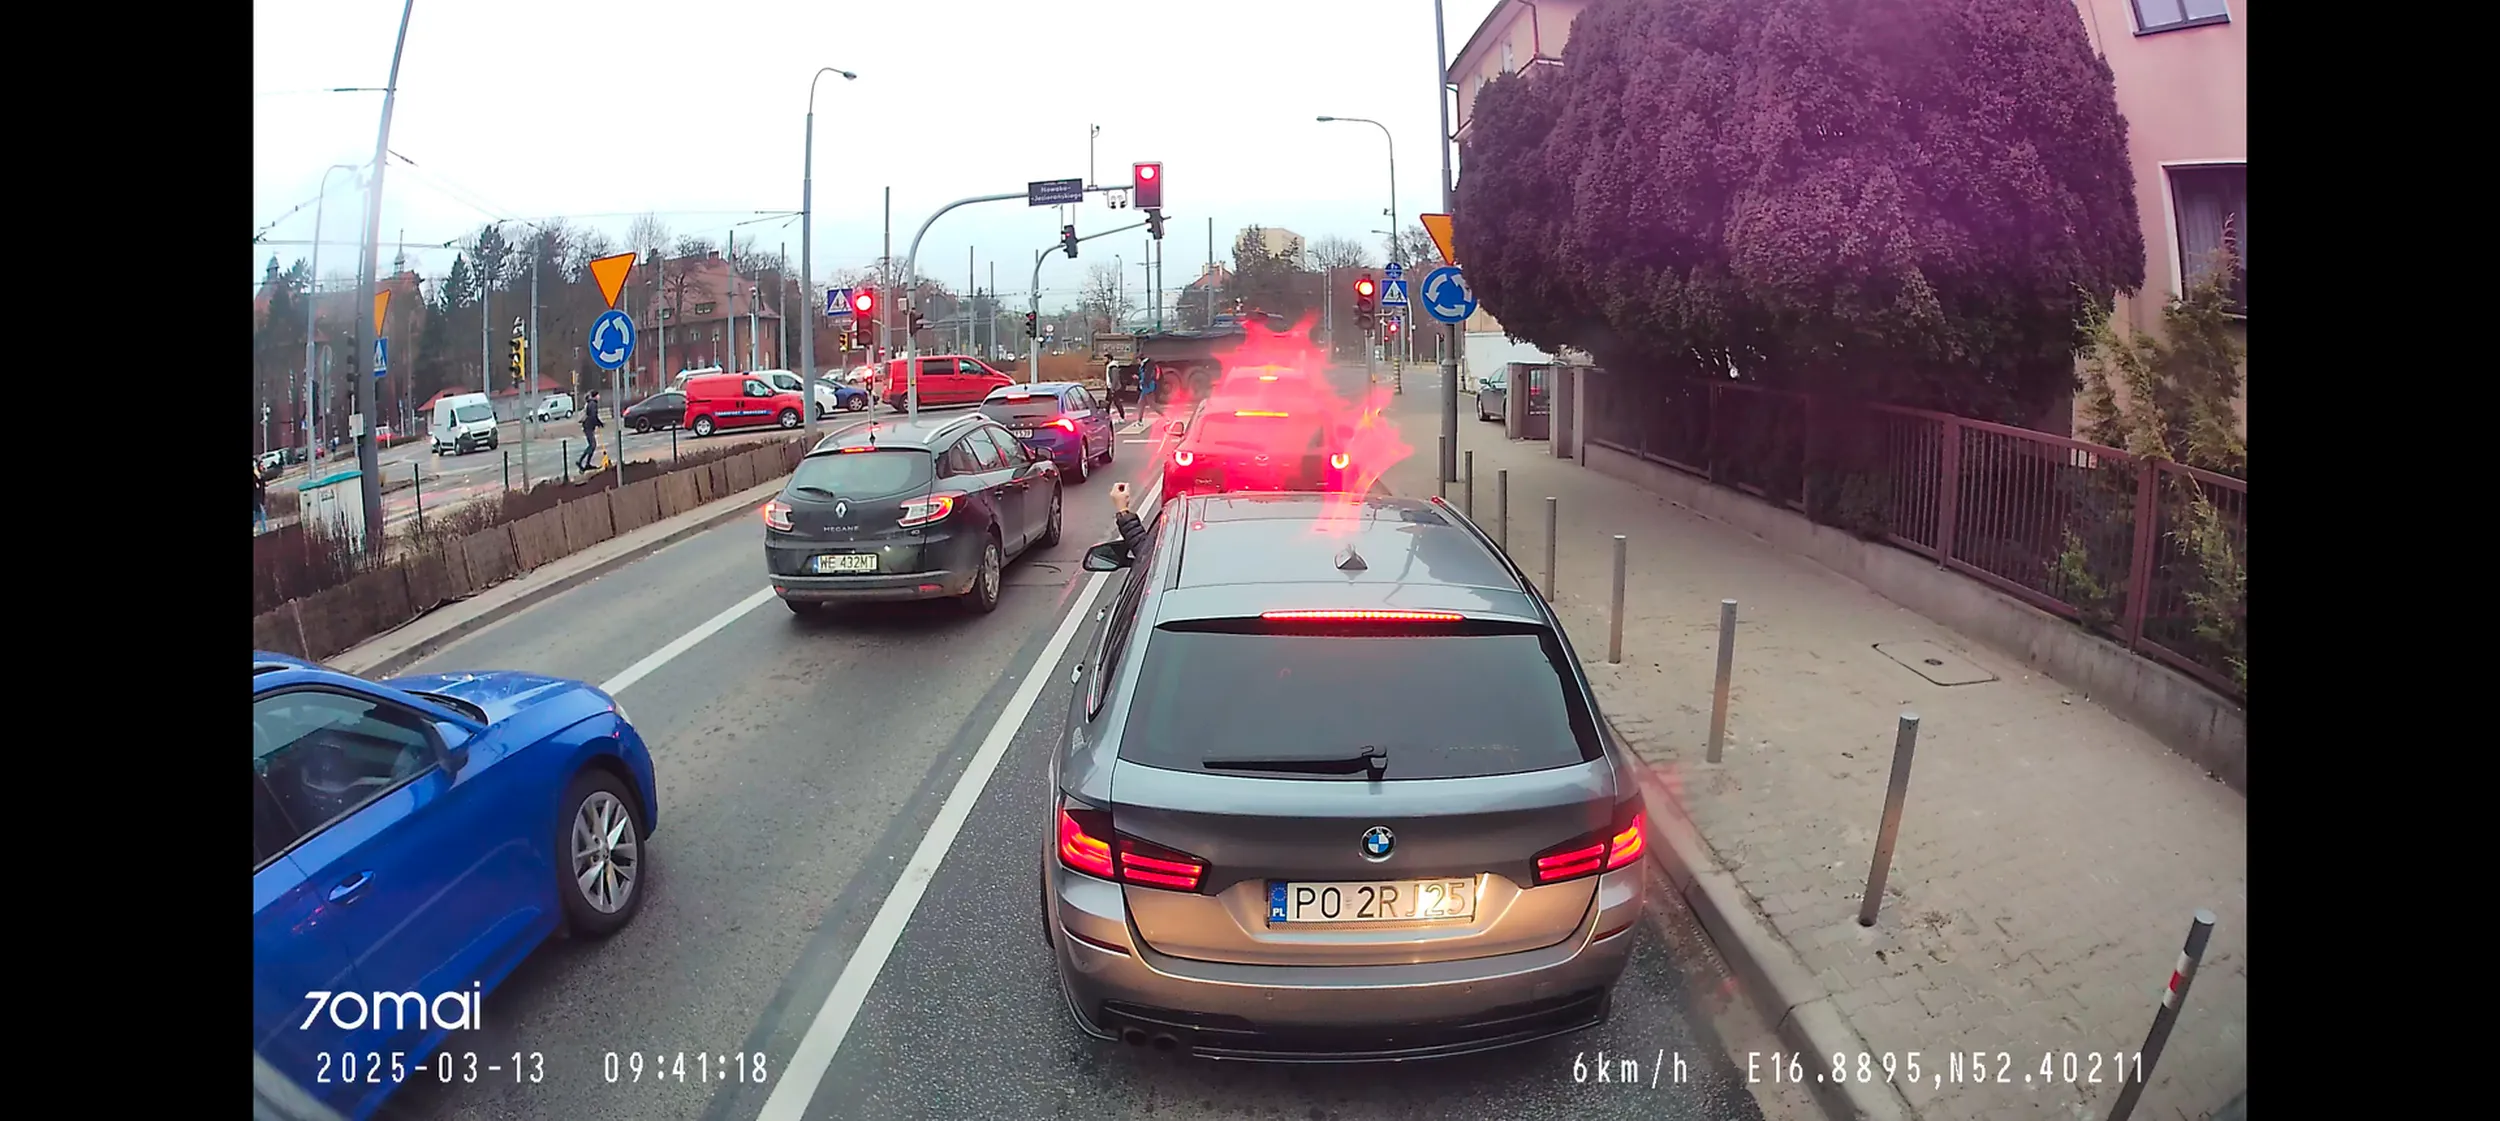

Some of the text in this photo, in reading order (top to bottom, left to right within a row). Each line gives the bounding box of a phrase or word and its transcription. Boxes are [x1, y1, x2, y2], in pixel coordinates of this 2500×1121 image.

[820, 556, 876, 569] WE 432MT
[1296, 882, 1465, 918] PO 2RJ25
[1272, 908, 1285, 917] PL
